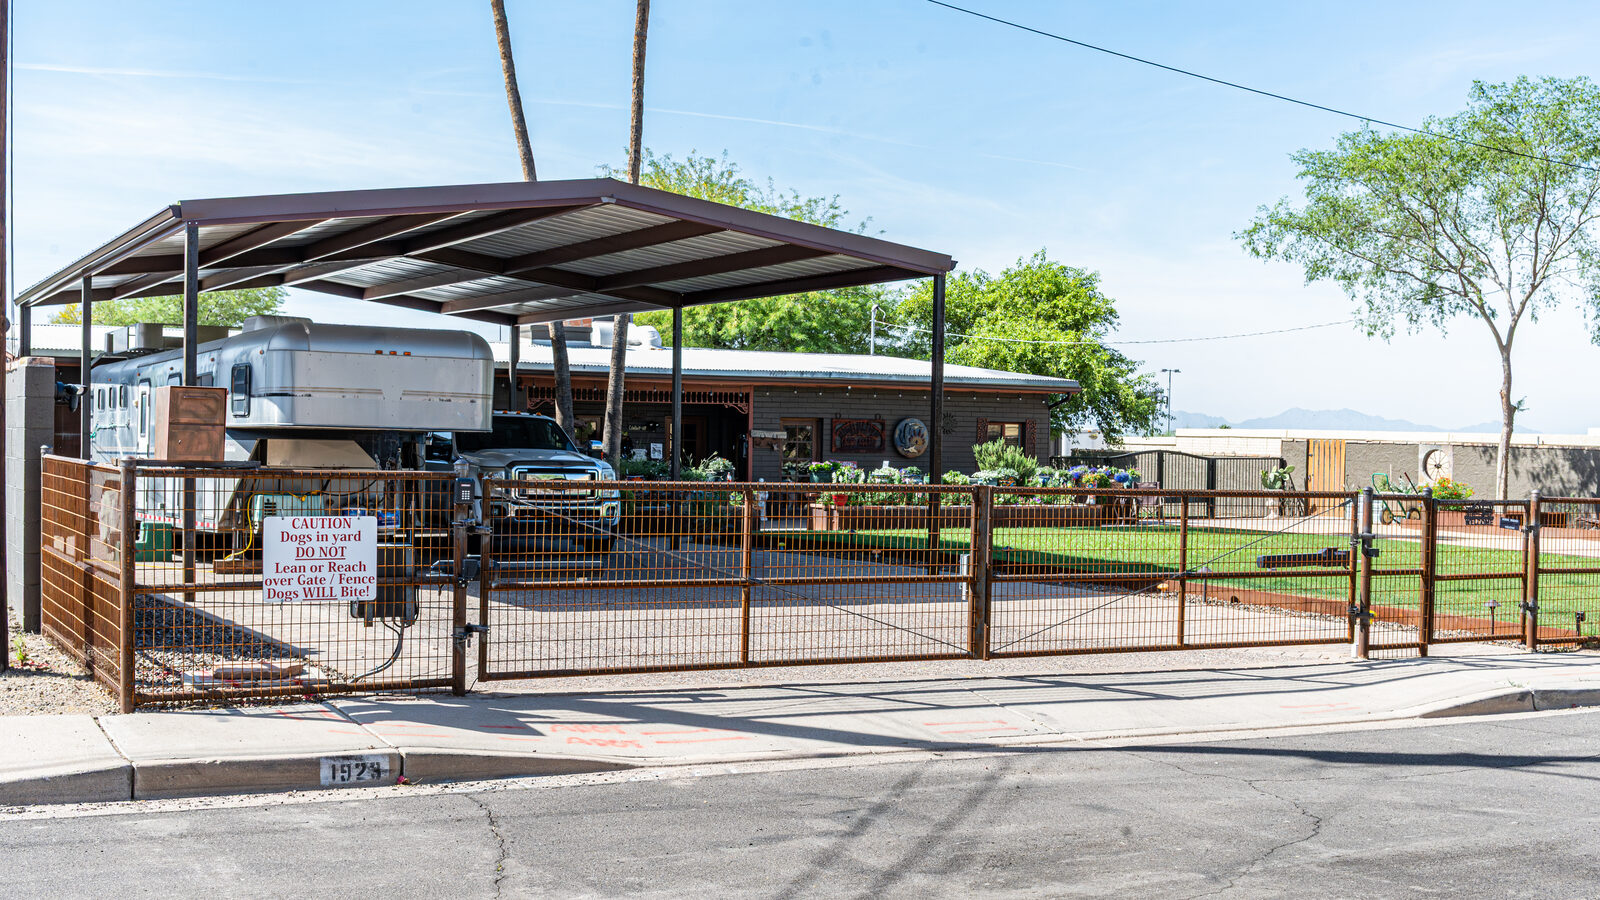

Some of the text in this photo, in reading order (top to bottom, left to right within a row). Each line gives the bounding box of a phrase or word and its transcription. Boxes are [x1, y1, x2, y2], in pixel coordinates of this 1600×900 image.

[292, 518, 351, 529] CAUTION
[280, 530, 361, 545] Dogs in yard
[296, 546, 347, 558] DO NOT
[275, 561, 366, 574] Lean or Reach
[264, 573, 376, 586] over Gate / Fence
[267, 586, 370, 602] Dogs WILL Bite!
